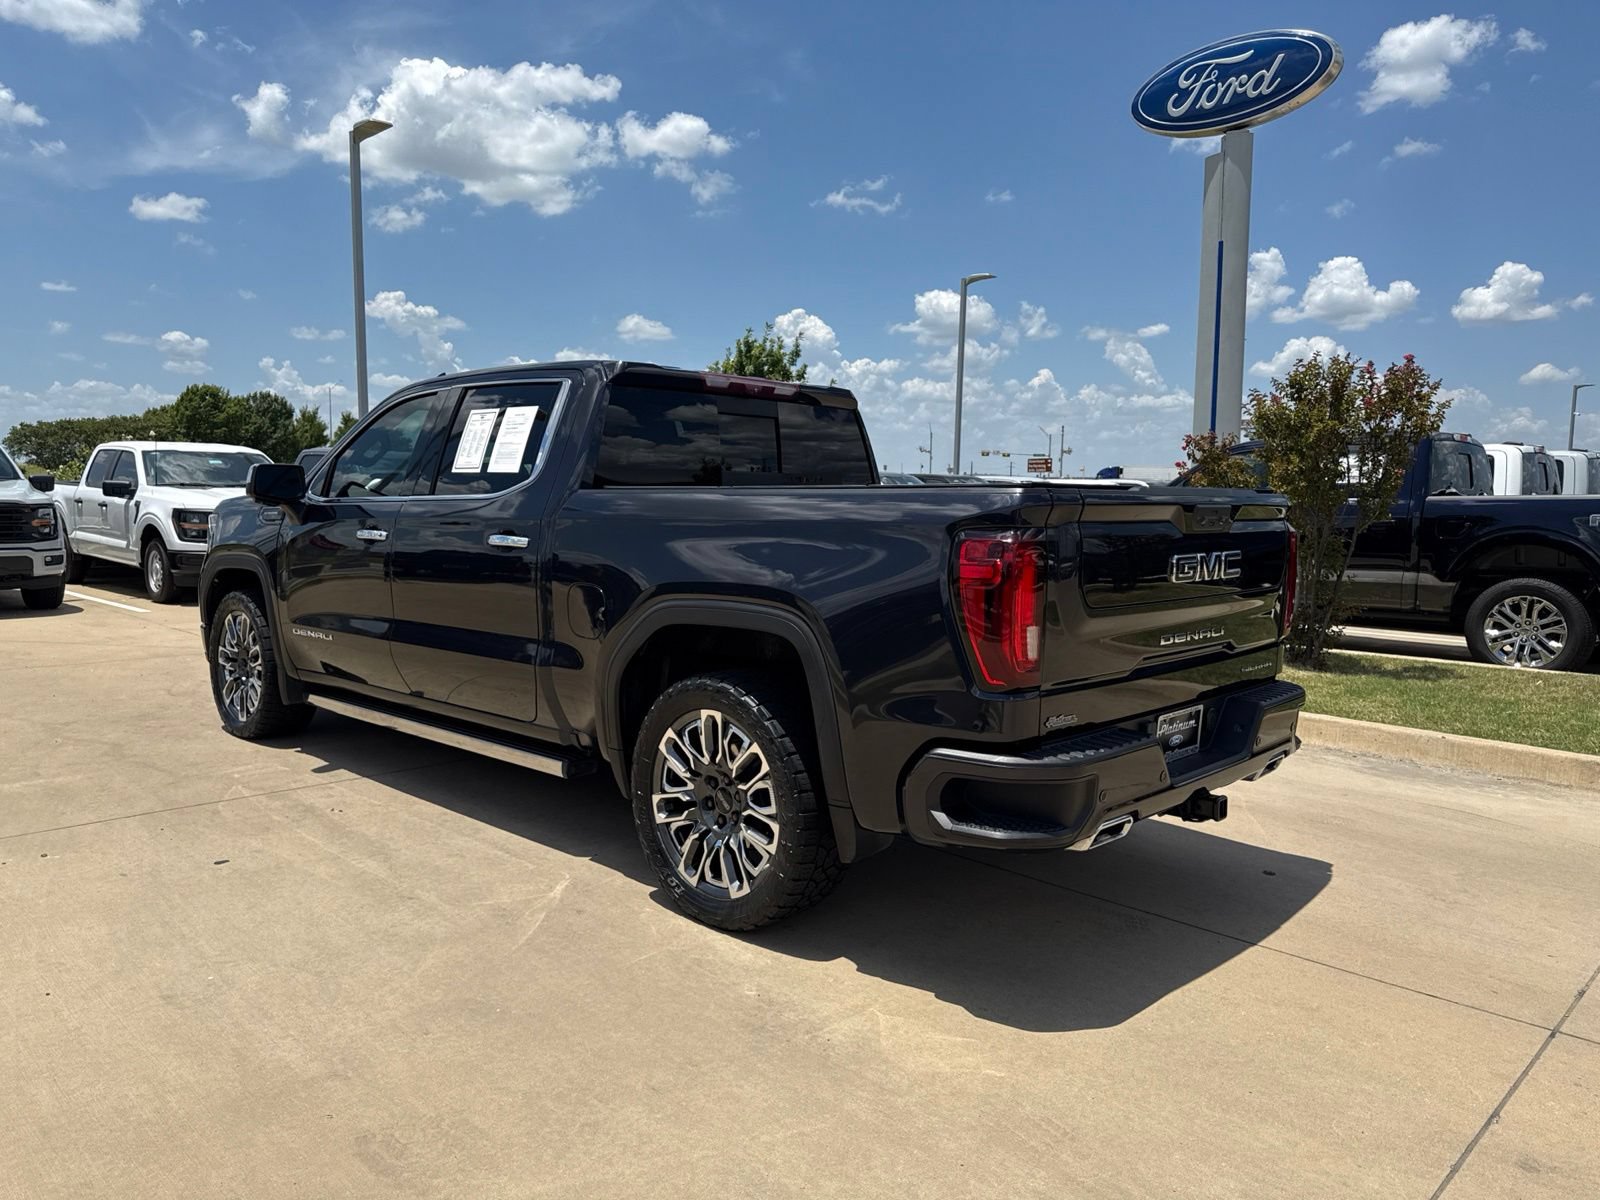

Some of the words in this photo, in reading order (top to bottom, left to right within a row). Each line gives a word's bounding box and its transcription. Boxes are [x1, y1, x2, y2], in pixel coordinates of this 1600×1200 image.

[1167, 50, 1285, 117] Ford
[1169, 550, 1241, 583] GMC
[292, 628, 334, 641] DENALI
[1160, 627, 1224, 645] DENALI
[1158, 720, 1197, 736] Platinum
